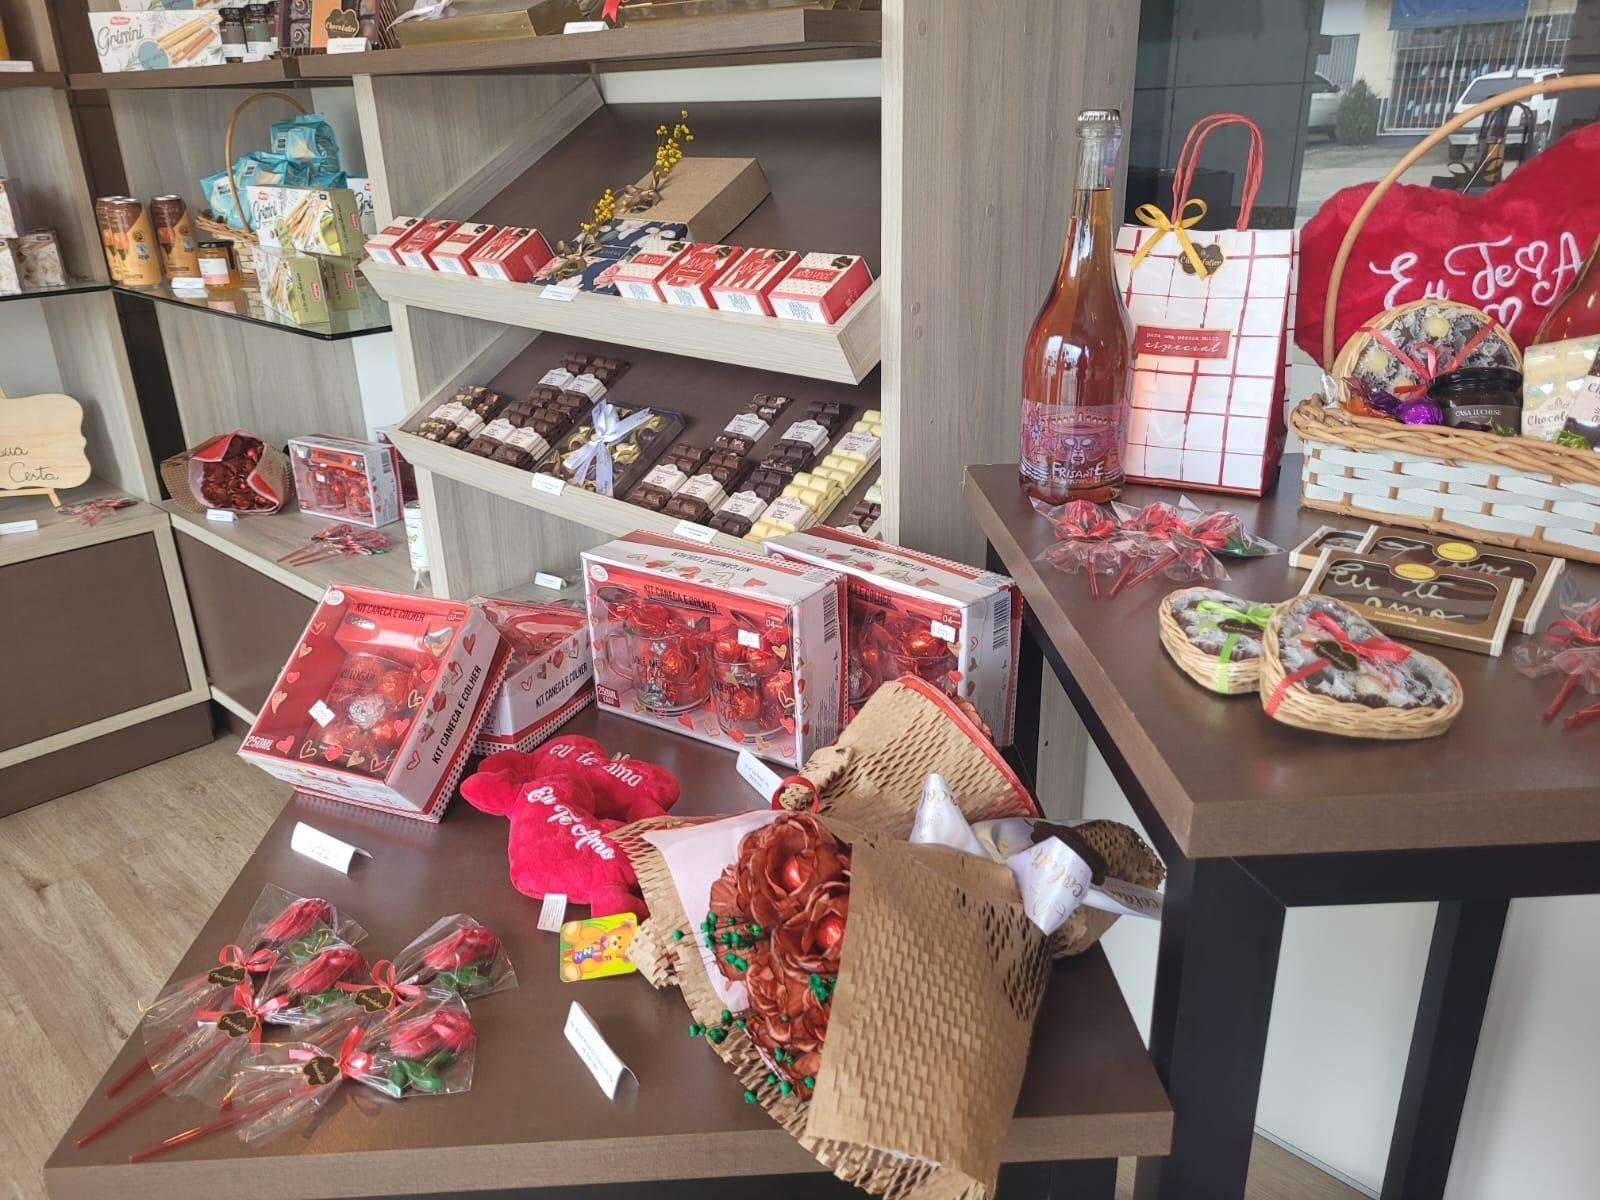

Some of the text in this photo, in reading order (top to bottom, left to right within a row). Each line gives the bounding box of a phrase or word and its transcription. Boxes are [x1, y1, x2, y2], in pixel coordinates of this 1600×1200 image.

[1144, 341, 1222, 353] especial
[1527, 411, 1568, 426] Chocol
[1052, 461, 1105, 479] FRISANTE
[355, 602, 367, 613] KIT
[366, 604, 393, 617] CANECA
[535, 694, 545, 709] KIT
[544, 680, 565, 702] CANECA
[569, 662, 588, 684] COLHER
[432, 664, 482, 765] KIT CANECA E COLHER
[247, 735, 273, 751] 250ML
[550, 743, 643, 788] eu te amo
[526, 785, 616, 861] Eu Te Amo
